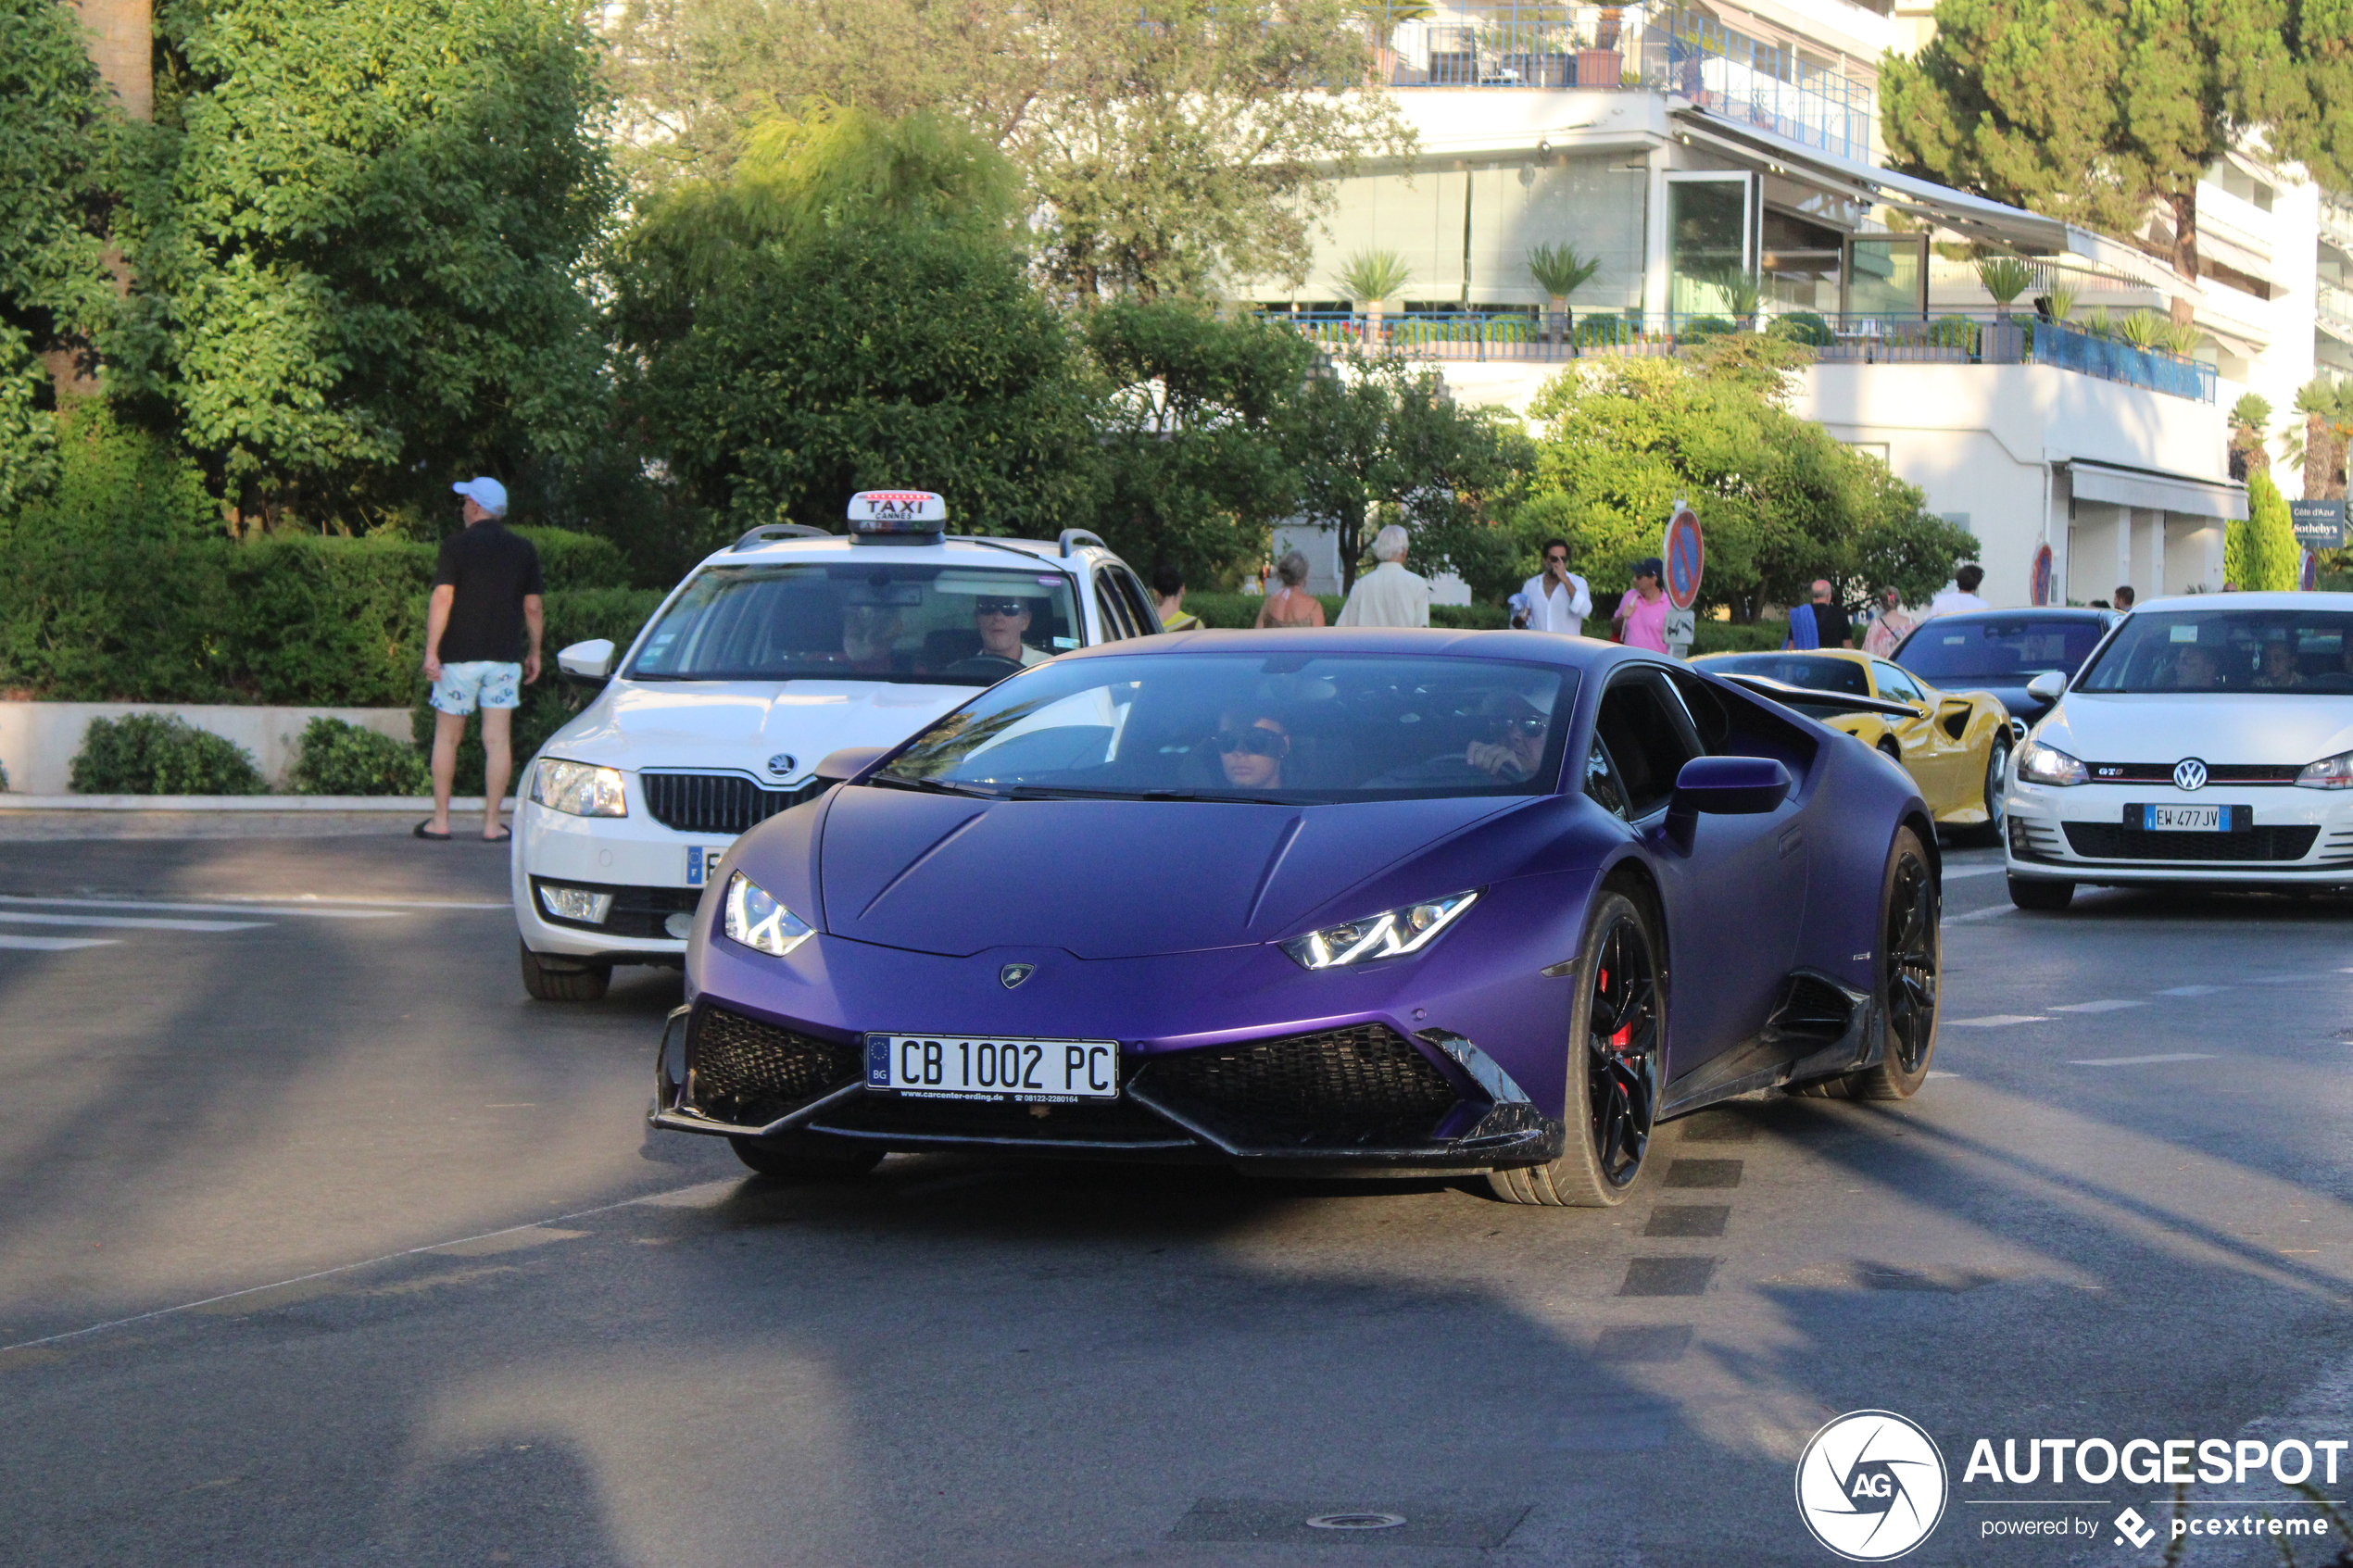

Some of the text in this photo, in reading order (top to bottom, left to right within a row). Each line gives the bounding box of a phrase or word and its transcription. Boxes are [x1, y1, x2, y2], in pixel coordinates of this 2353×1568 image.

[866, 500, 924, 514] TAXI
[2294, 523, 2338, 535] Sotheby's
[900, 1040, 1109, 1091] CB 1002 PC
[873, 1069, 887, 1080] BG
[900, 1090, 1078, 1103] www.carcenter-erding.de 08122-2280164
